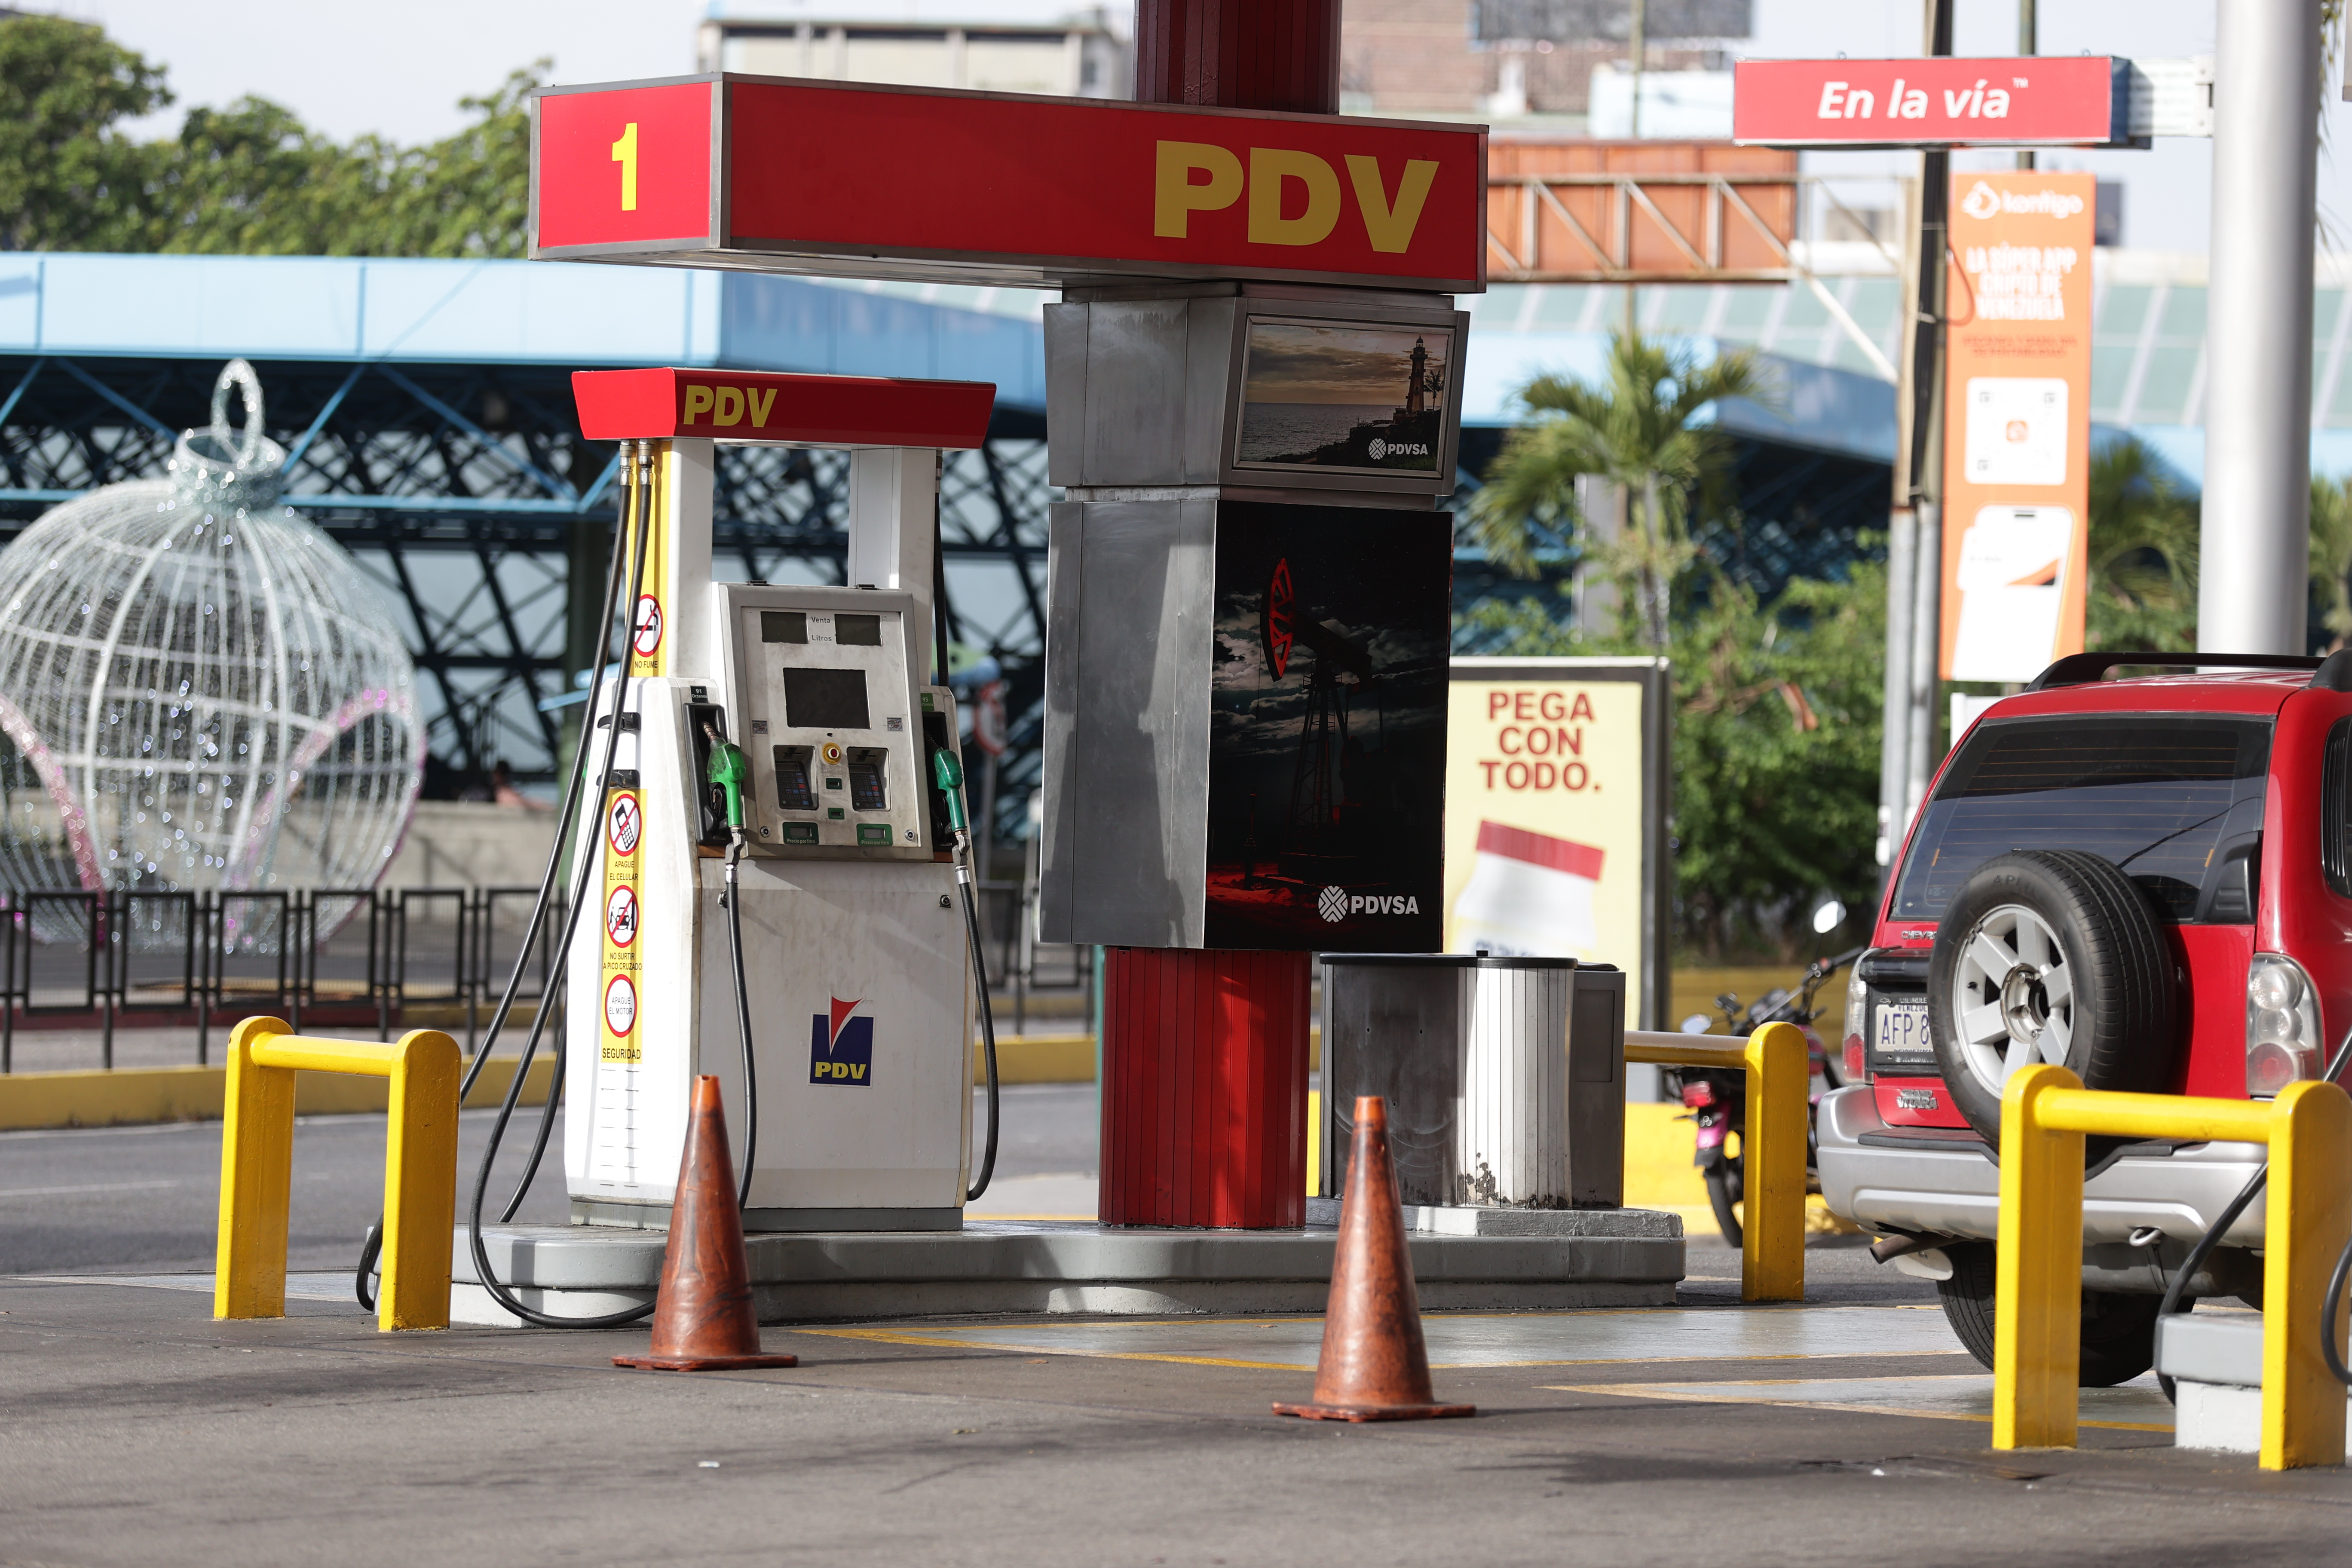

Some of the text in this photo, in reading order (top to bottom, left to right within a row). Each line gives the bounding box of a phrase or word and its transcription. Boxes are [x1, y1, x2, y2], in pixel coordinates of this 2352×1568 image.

[1816, 82, 1874, 119] En
[1887, 79, 1928, 119] la
[612, 122, 637, 211] 1
[1154, 140, 1440, 254] PDV
[2002, 189, 2085, 219] kontigo
[1966, 241, 2077, 273] LA SÚPER APP
[1979, 273, 2063, 297] CRIPTO DE
[1977, 297, 2065, 321] VENEZUELA
[683, 385, 778, 428] PDV
[1387, 443, 1428, 456] PDVSA
[643, 661, 658, 669] FUME
[1489, 692, 1595, 721] PEGA
[1499, 727, 1582, 756] CON
[1479, 762, 1602, 791] TODO.
[1351, 895, 1419, 915] PDVSA
[1902, 930, 1937, 940] CHEVRO
[619, 962, 642, 971] CRUZADO
[1881, 1013, 1913, 1045] AFP
[602, 1048, 641, 1060] SEGURIDAD
[815, 1062, 867, 1079] PDV
[1896, 1096, 1938, 1109] VITARA
